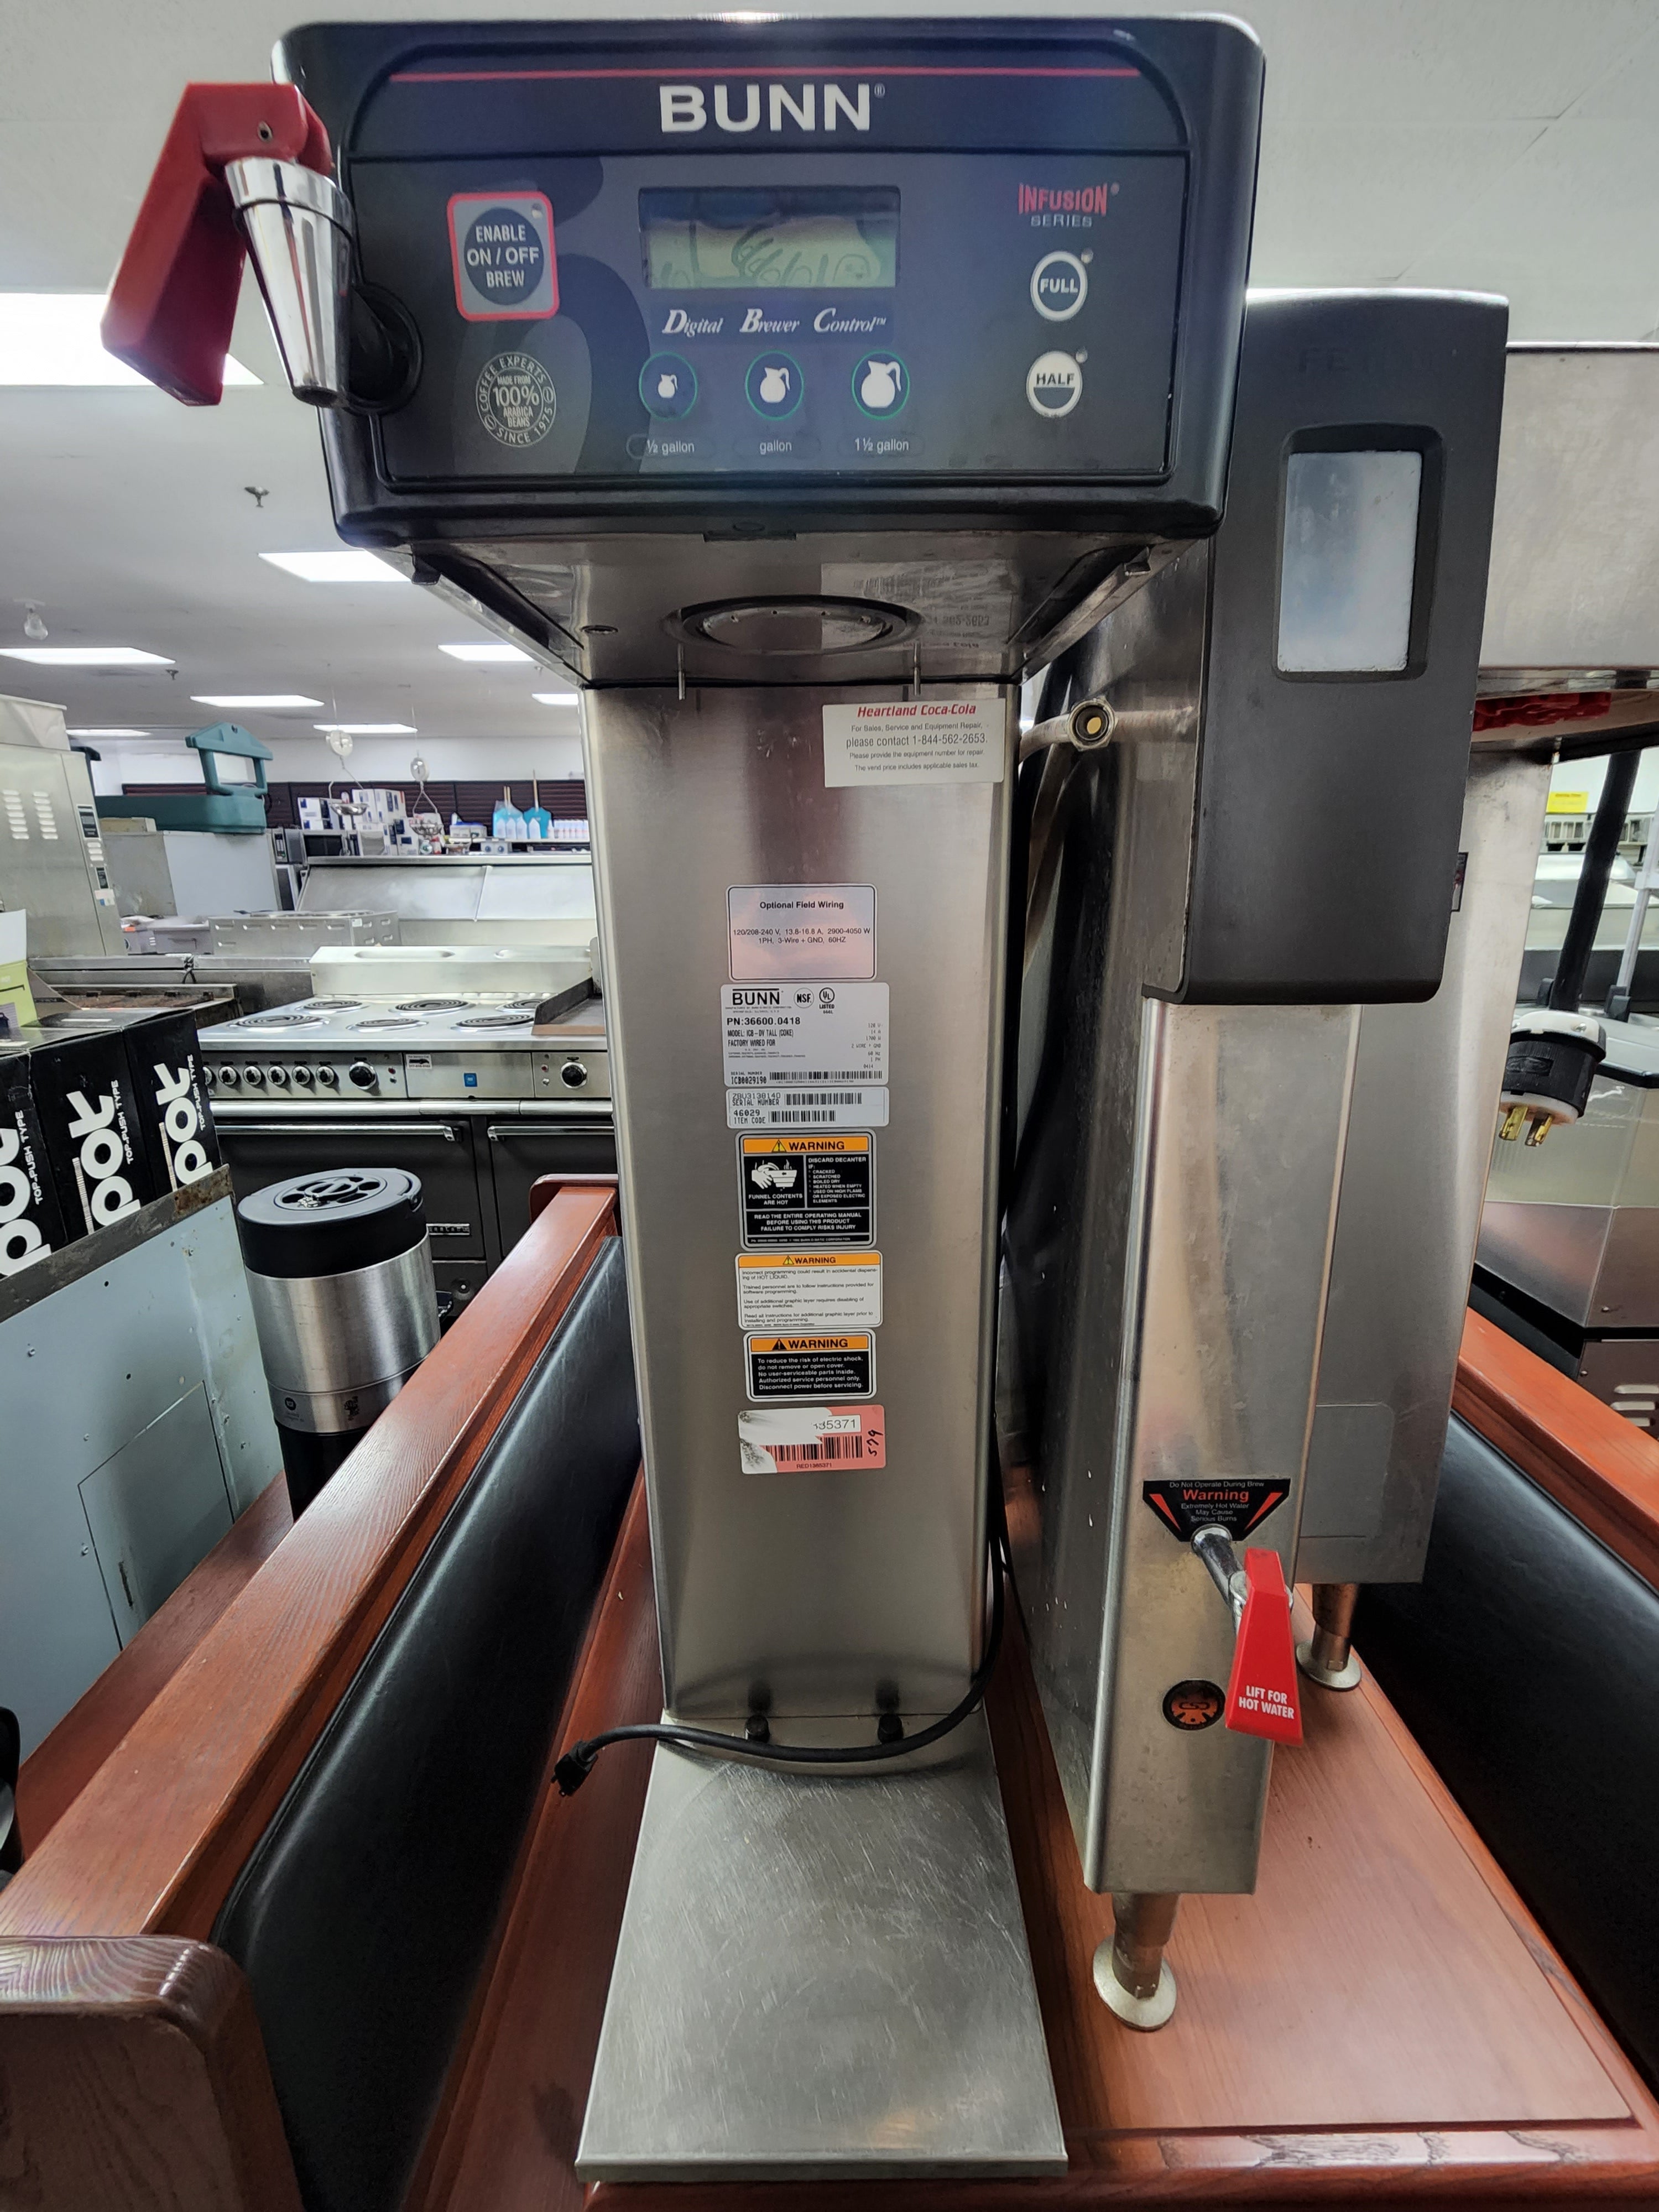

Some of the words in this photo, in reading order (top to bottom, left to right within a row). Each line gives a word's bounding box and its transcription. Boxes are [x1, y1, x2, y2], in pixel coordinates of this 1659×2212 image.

[1018, 182, 1107, 216] INFUSION
[1031, 215, 1092, 227] SERIES
[475, 223, 526, 243] ENABLE
[467, 248, 493, 266] ON
[505, 247, 539, 265] OFF
[487, 270, 524, 289] BREW
[1040, 279, 1078, 293] FULL
[662, 309, 723, 337] Digital
[739, 309, 800, 332] Brewer
[479, 364, 498, 411] COFFEE
[499, 356, 546, 383] EXPERTS
[498, 375, 513, 385] MADE
[514, 375, 531, 384] FROM
[1036, 373, 1076, 386] HALF
[493, 385, 539, 406] 100%
[503, 406, 534, 418] ARABICA
[497, 427, 531, 444] SINCE
[534, 406, 552, 437] 1975
[508, 417, 530, 427] BEANS
[662, 441, 695, 456] gallon
[759, 441, 792, 455] gallon
[877, 439, 909, 454] gallon
[858, 705, 917, 717] Heartland
[921, 703, 975, 716] Coca-Cola
[925, 722, 958, 731] Equipment
[961, 722, 983, 730] Repair,
[847, 737, 874, 749] please
[877, 735, 909, 746] contact
[883, 764, 896, 772] price
[760, 901, 794, 910] Optional
[818, 901, 844, 909] Wiring
[733, 992, 780, 1005] BUNN
[727, 1017, 800, 1025] PN:36600.0418
[779, 1029, 794, 1037] (COKE)
[187, 1054, 196, 1081] TYPE
[111, 1079, 122, 1109] TYPE
[192, 1083, 206, 1131] TOP-PUSH
[15, 1110, 32, 1144] TYPE
[117, 1112, 134, 1165] TOP-PUSH
[789, 1141, 844, 1151] WARNING
[23, 1145, 43, 1205] TOP-PUSH
[788, 1339, 848, 1349] WARNING
[1183, 1489, 1249, 1503] Warning
[1246, 1685, 1265, 1699] LIFT
[1268, 1689, 1287, 1704] FOR
[1239, 1696, 1259, 1712] HOT
[1261, 1701, 1294, 1719] WATER
